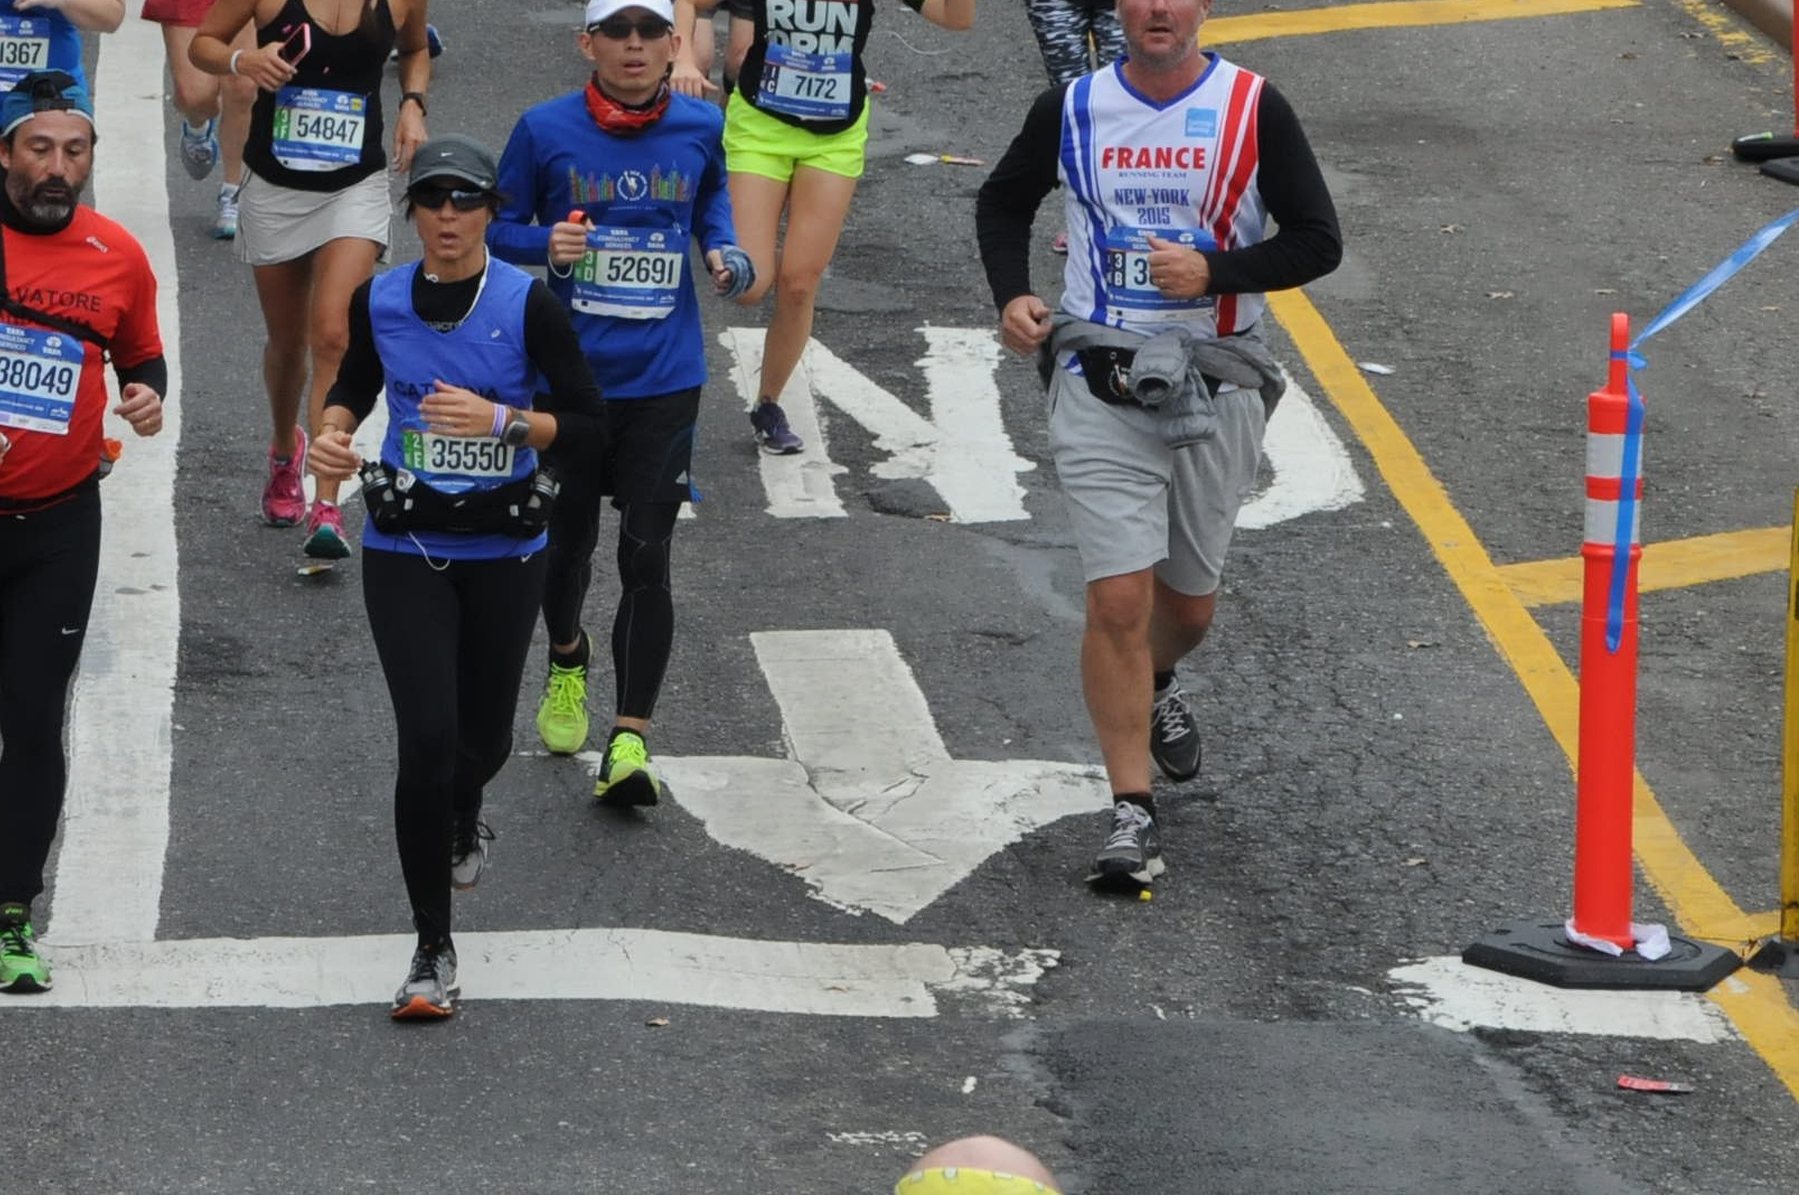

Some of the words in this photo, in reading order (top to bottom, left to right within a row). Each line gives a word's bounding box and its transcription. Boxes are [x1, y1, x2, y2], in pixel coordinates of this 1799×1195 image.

[794, 75, 837, 102] 7172
[296, 113, 359, 145] 54847
[1101, 146, 1206, 170] FRANCE
[1114, 188, 1190, 207] NEW-YORK
[1137, 207, 1171, 225] 2015
[606, 256, 674, 284] 52691
[432, 439, 509, 472] 35550
